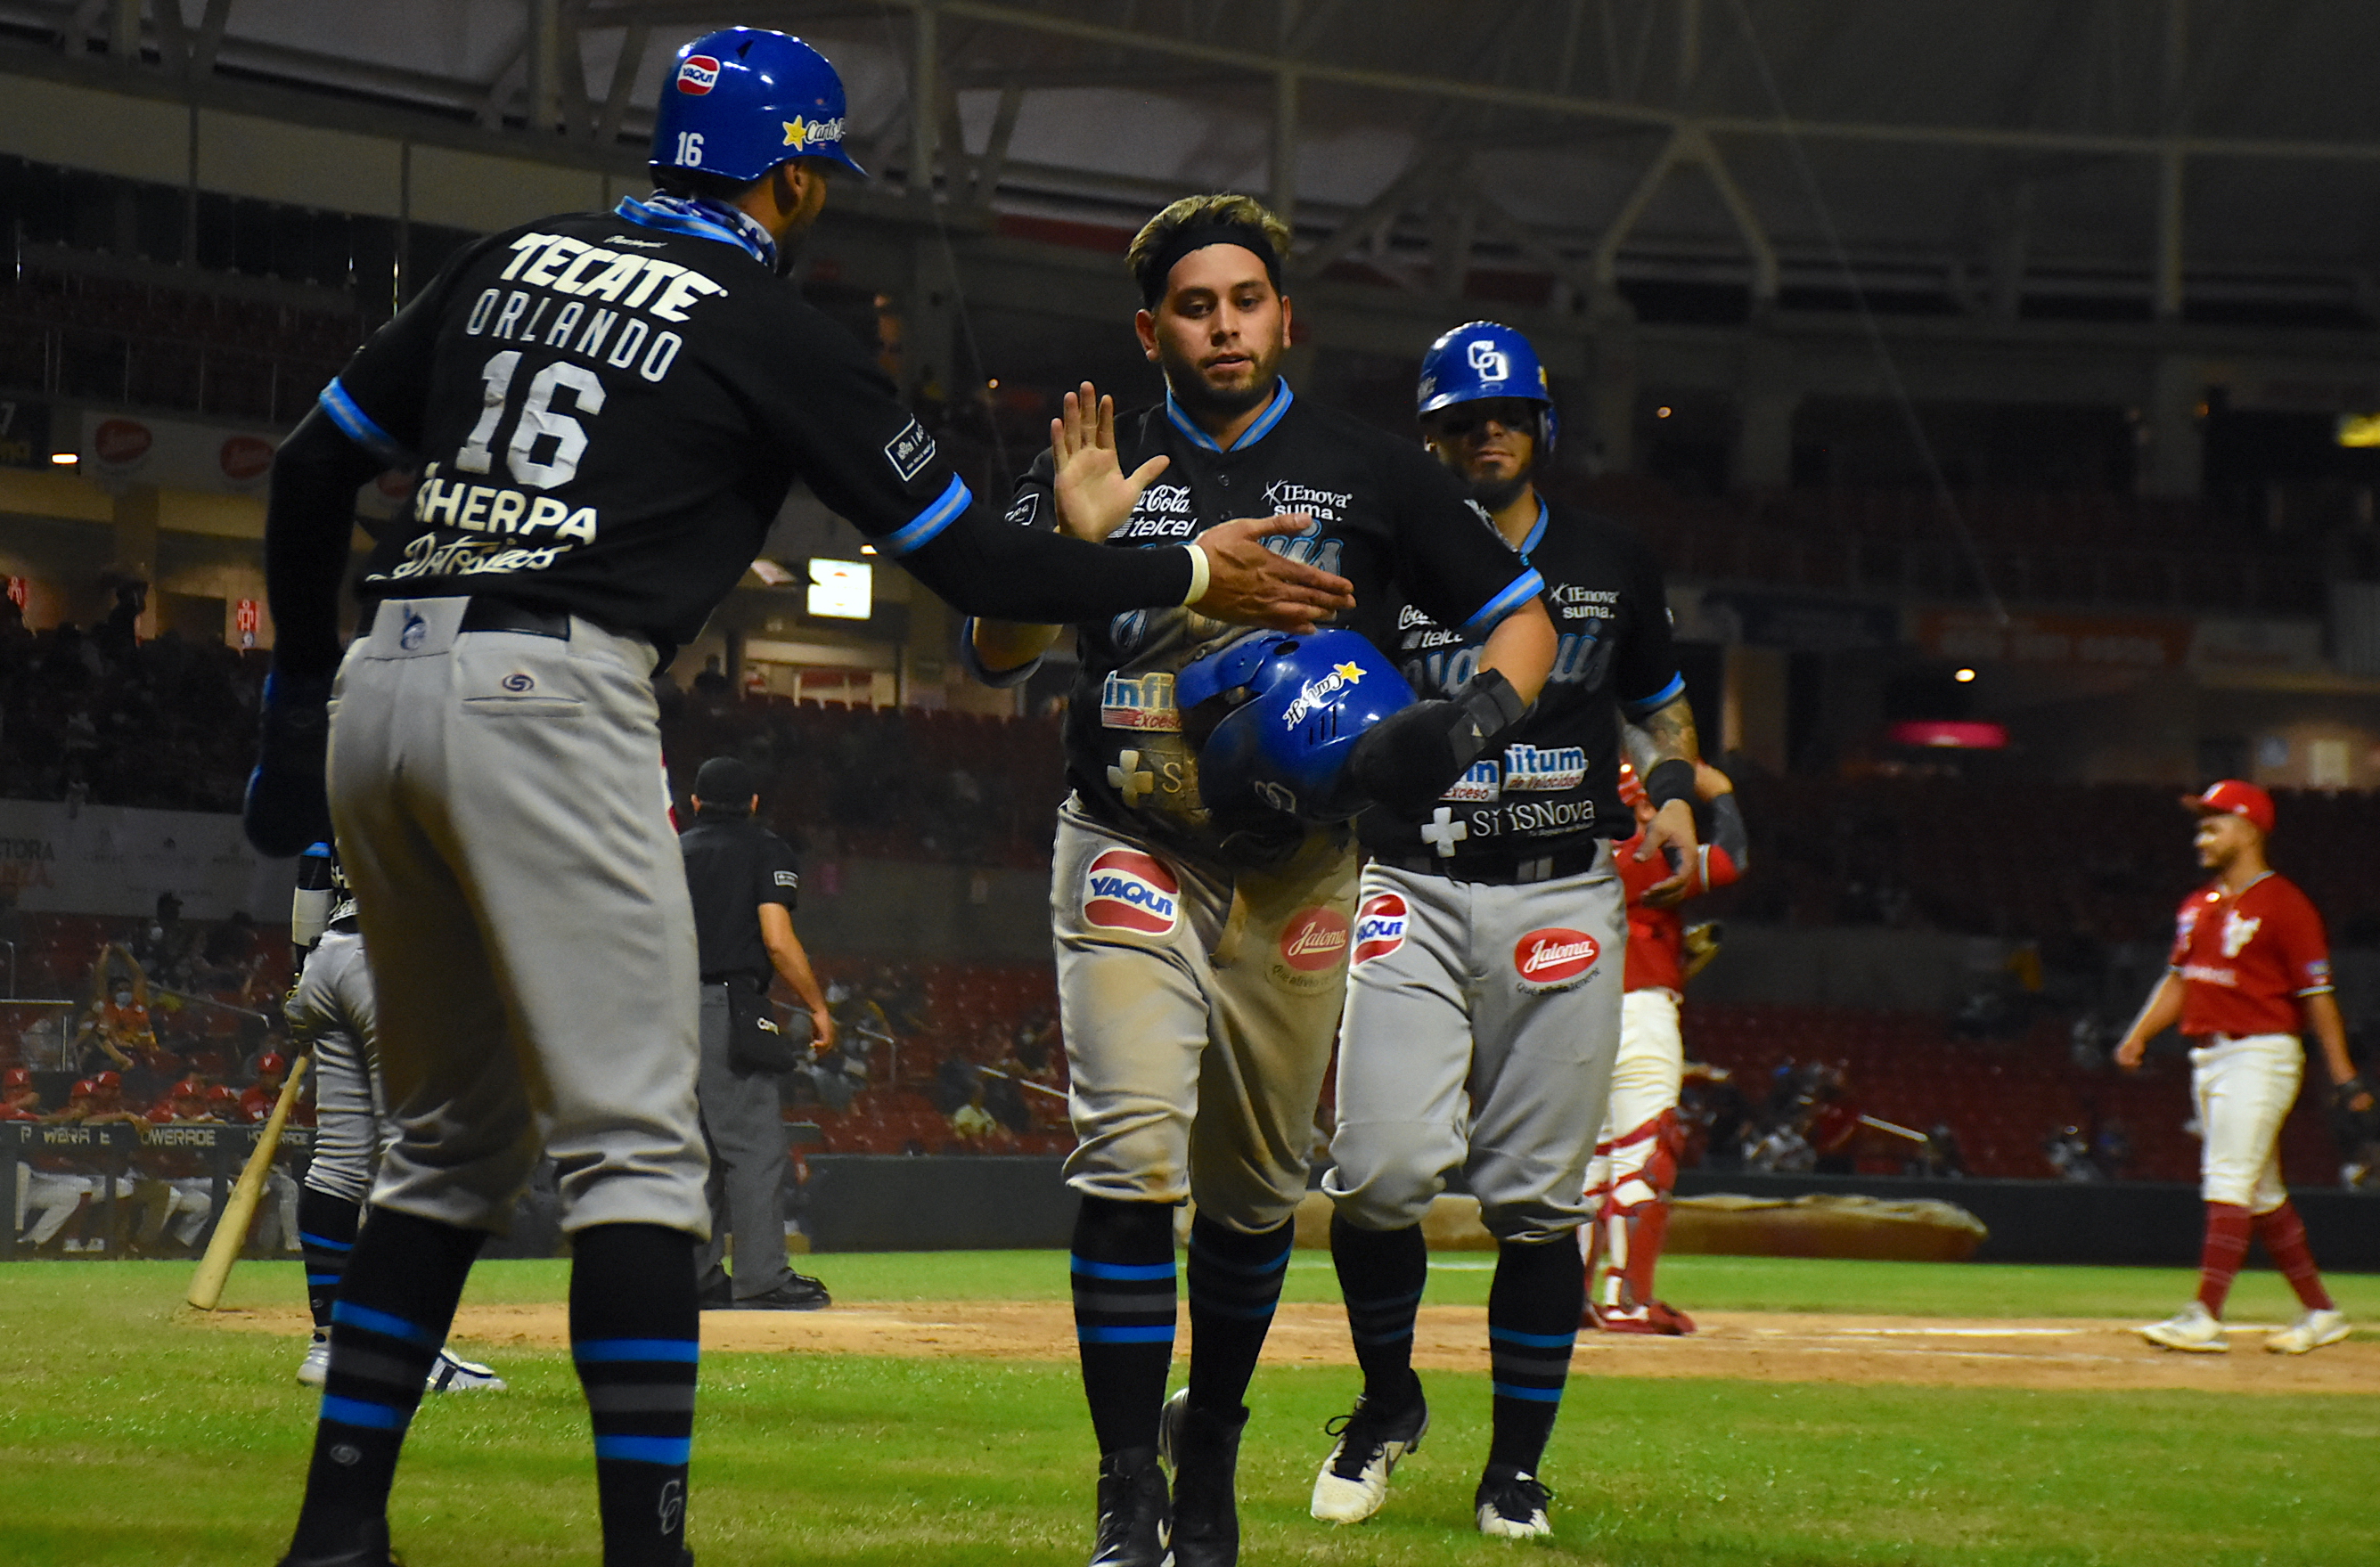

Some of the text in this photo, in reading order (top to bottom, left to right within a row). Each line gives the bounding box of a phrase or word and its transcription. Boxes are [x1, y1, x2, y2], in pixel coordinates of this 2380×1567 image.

[675, 131, 704, 167] 16
[500, 232, 723, 323] TECATE
[465, 288, 683, 383] ORLANDO
[454, 348, 608, 490] 16
[414, 461, 598, 545] SHERPA
[1129, 515, 1198, 537] telcel
[1090, 876, 1173, 916] YAQUI
[1288, 921, 1346, 957] Jaloma
[1523, 939, 1595, 974] Jaloma
[141, 1129, 216, 1147] OWERADE
